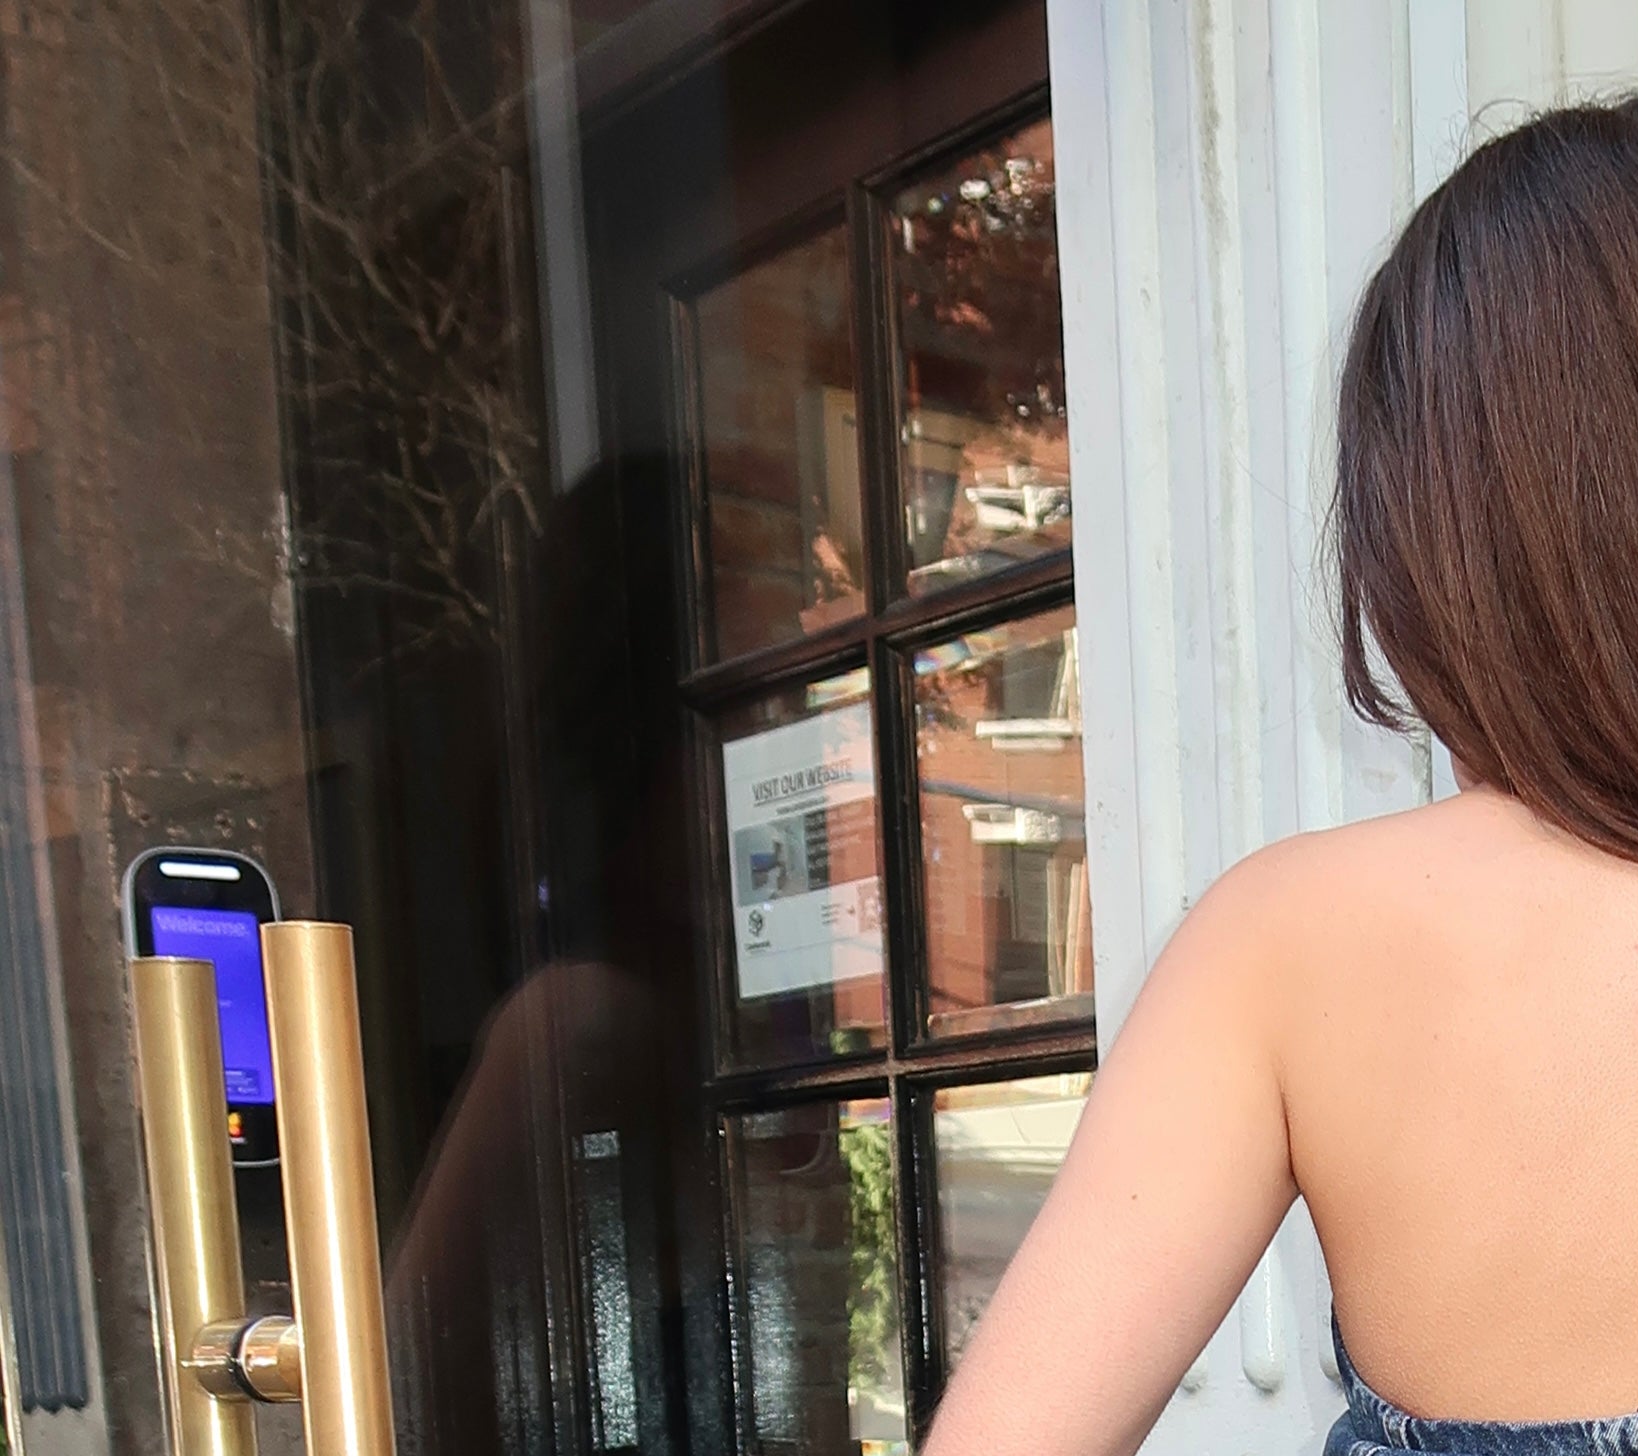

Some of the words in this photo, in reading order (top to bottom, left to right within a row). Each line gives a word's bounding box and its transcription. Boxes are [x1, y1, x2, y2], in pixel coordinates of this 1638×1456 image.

[752, 777, 779, 802] VISIT
[780, 770, 804, 795] OUR
[805, 759, 853, 786] WEBSITE
